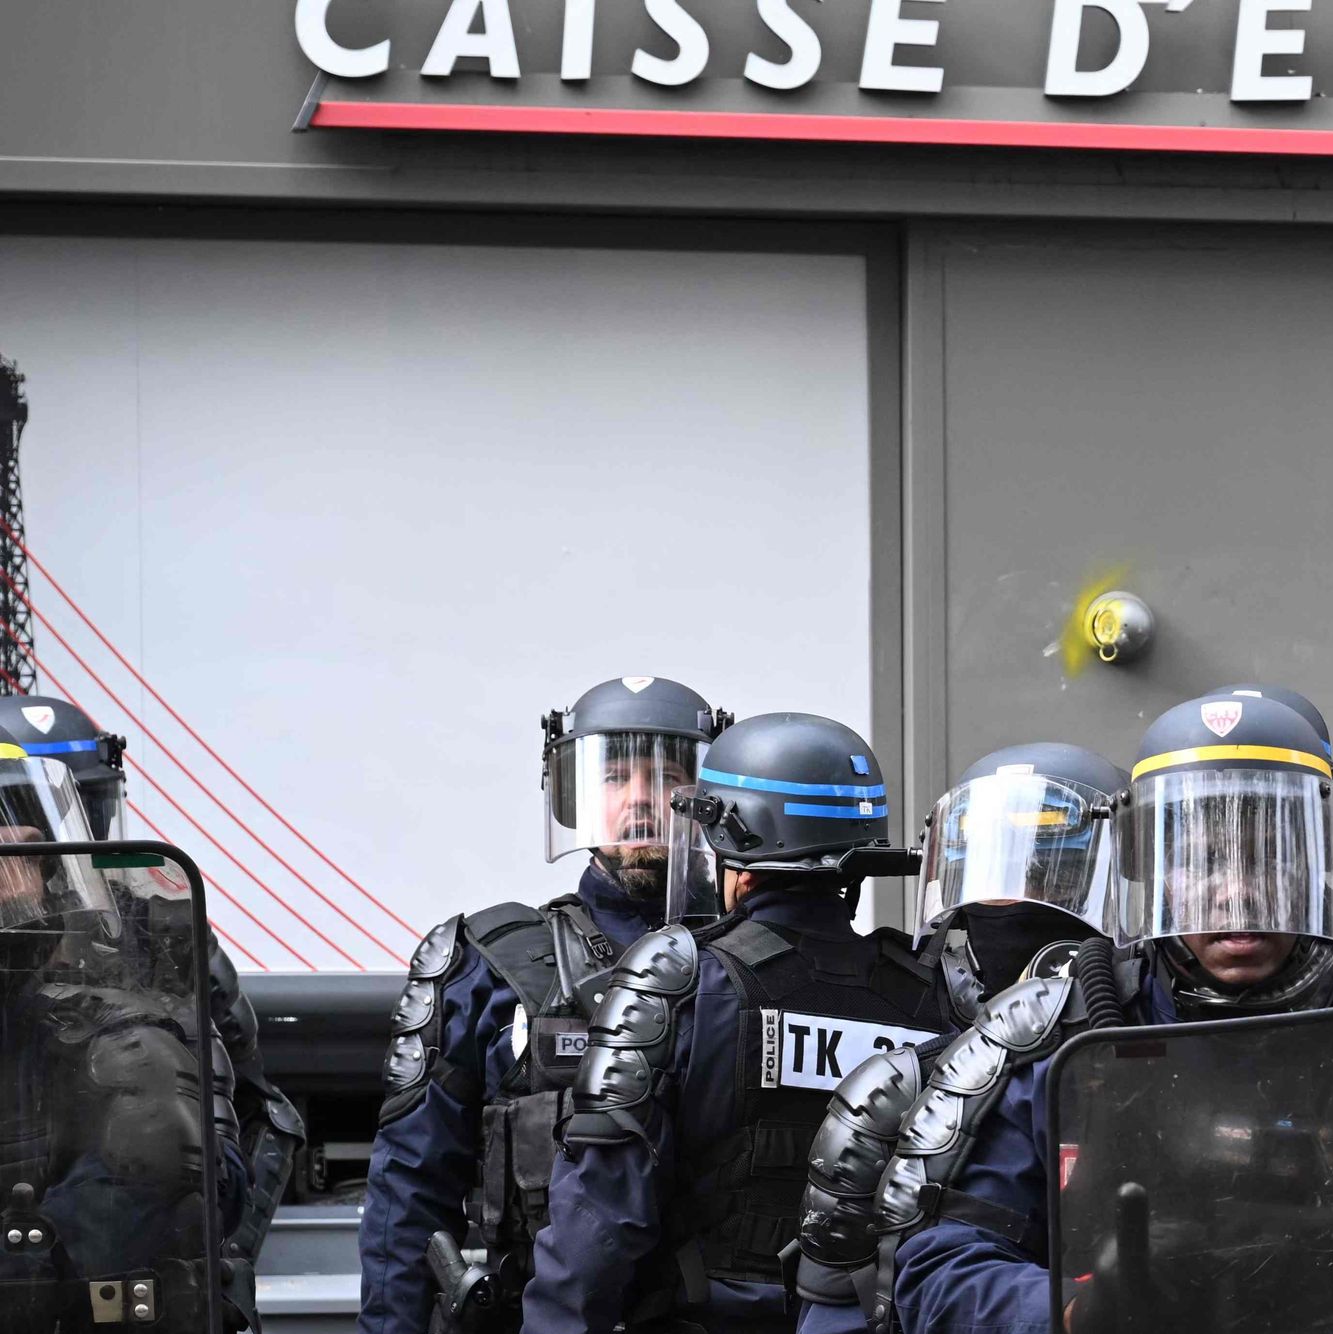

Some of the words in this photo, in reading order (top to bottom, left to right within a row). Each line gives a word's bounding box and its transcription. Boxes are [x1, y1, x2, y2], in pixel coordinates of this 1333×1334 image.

[294, 0, 944, 93] CAISSE
[765, 1014, 776, 1083] POLICE
[787, 1023, 844, 1079] TK
